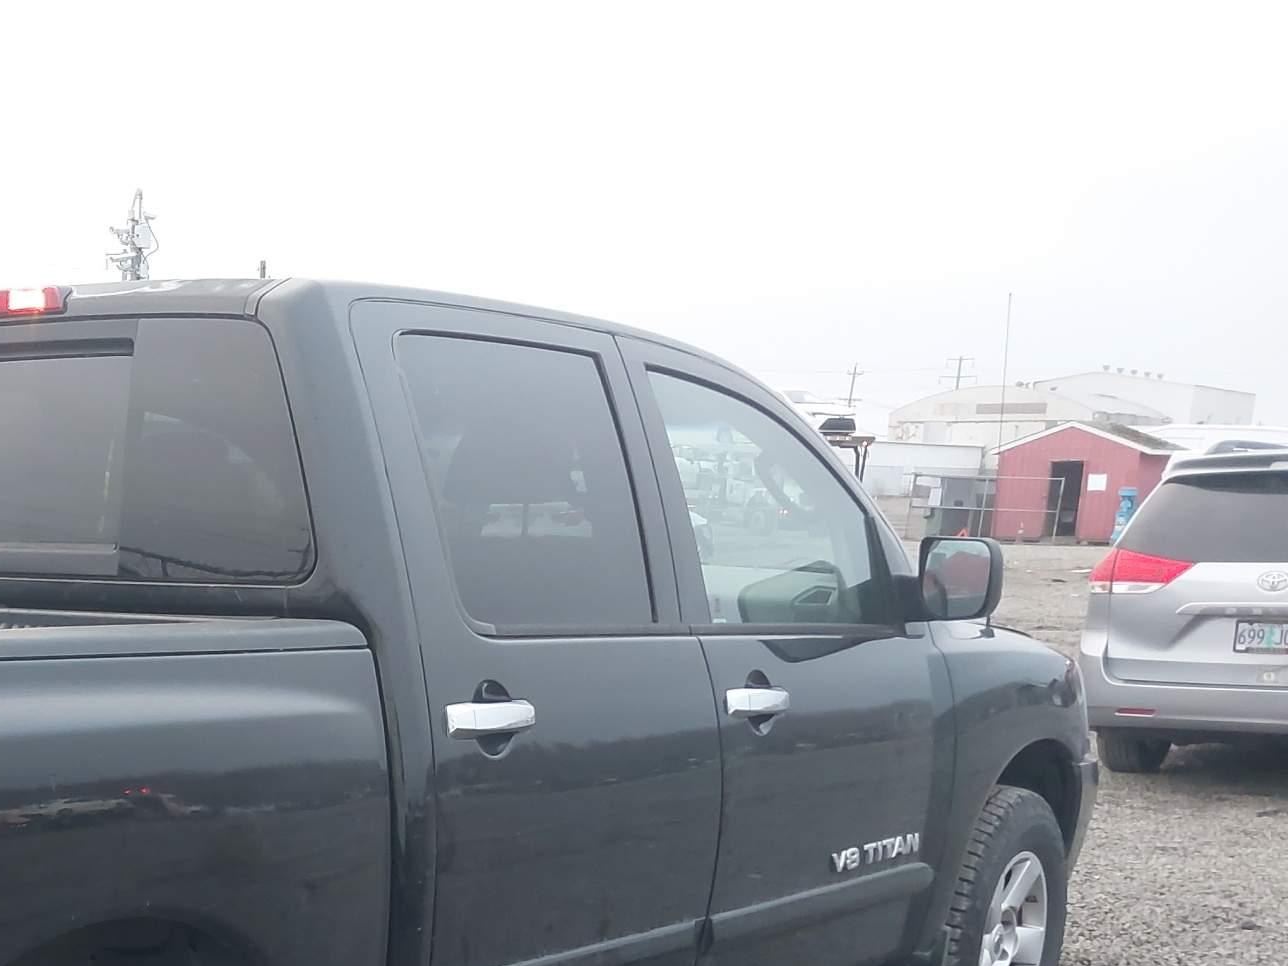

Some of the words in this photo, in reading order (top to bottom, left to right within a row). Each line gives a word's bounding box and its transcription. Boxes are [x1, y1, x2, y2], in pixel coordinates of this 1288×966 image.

[1238, 629, 1265, 645] 699
[832, 847, 860, 873] V8
[863, 832, 920, 865] TITAN
